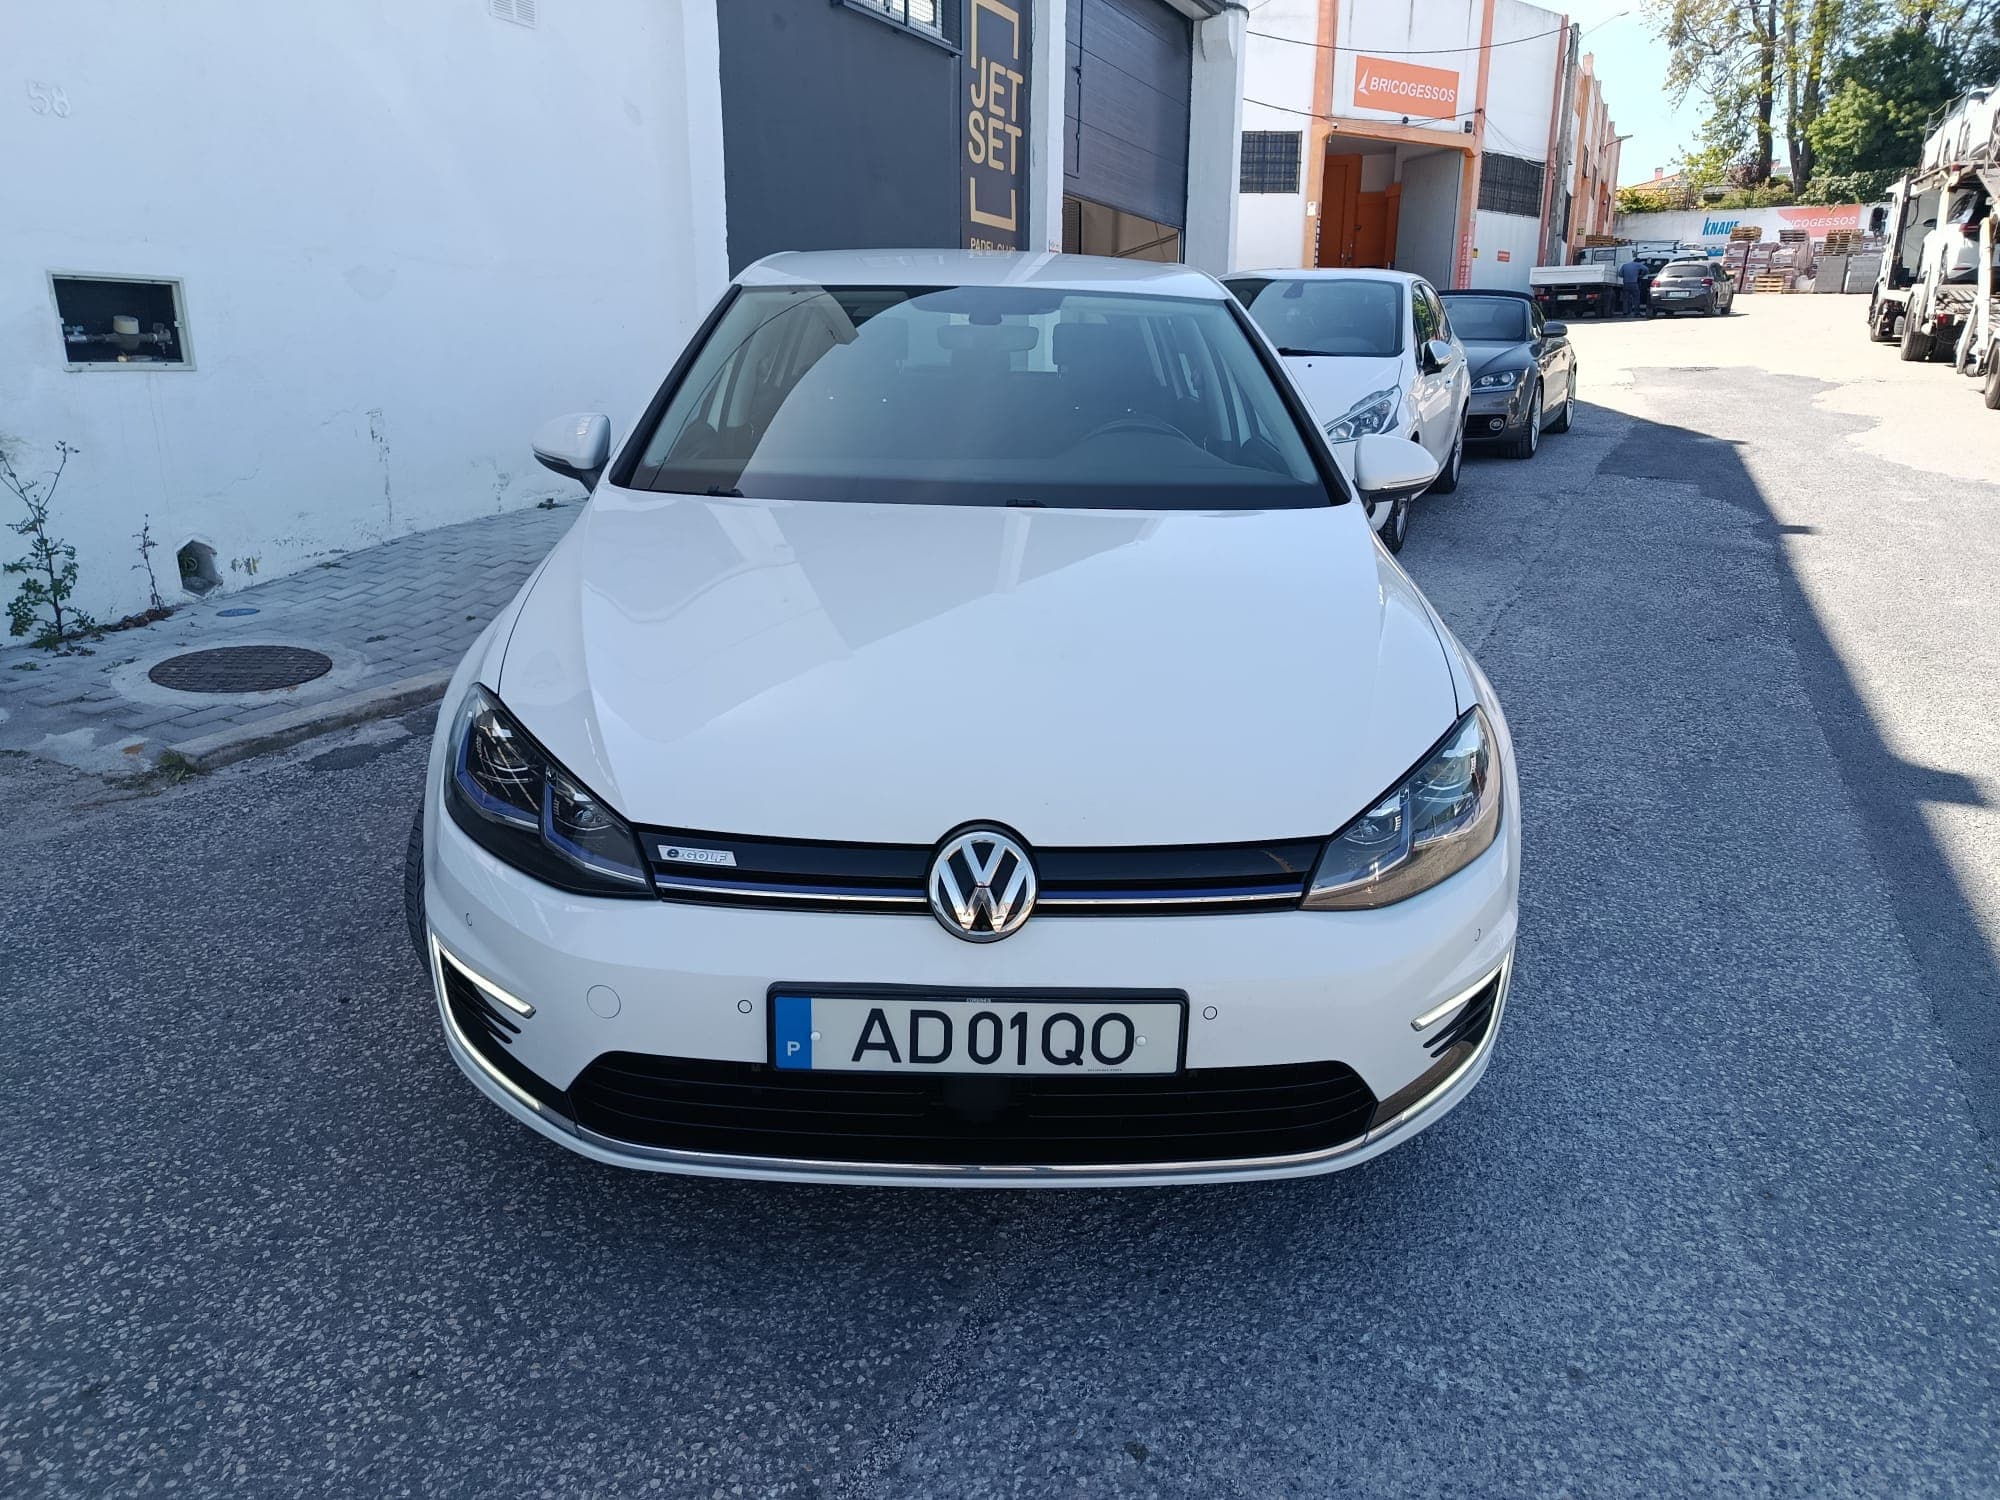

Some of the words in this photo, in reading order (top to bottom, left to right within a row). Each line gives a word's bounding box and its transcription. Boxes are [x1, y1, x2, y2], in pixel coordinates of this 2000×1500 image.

[26, 79, 71, 118] 58
[970, 56, 1024, 122] JET
[1370, 77, 1456, 103] BRICOGESSOS
[968, 110, 1023, 175] SET
[786, 1040, 801, 1057] P
